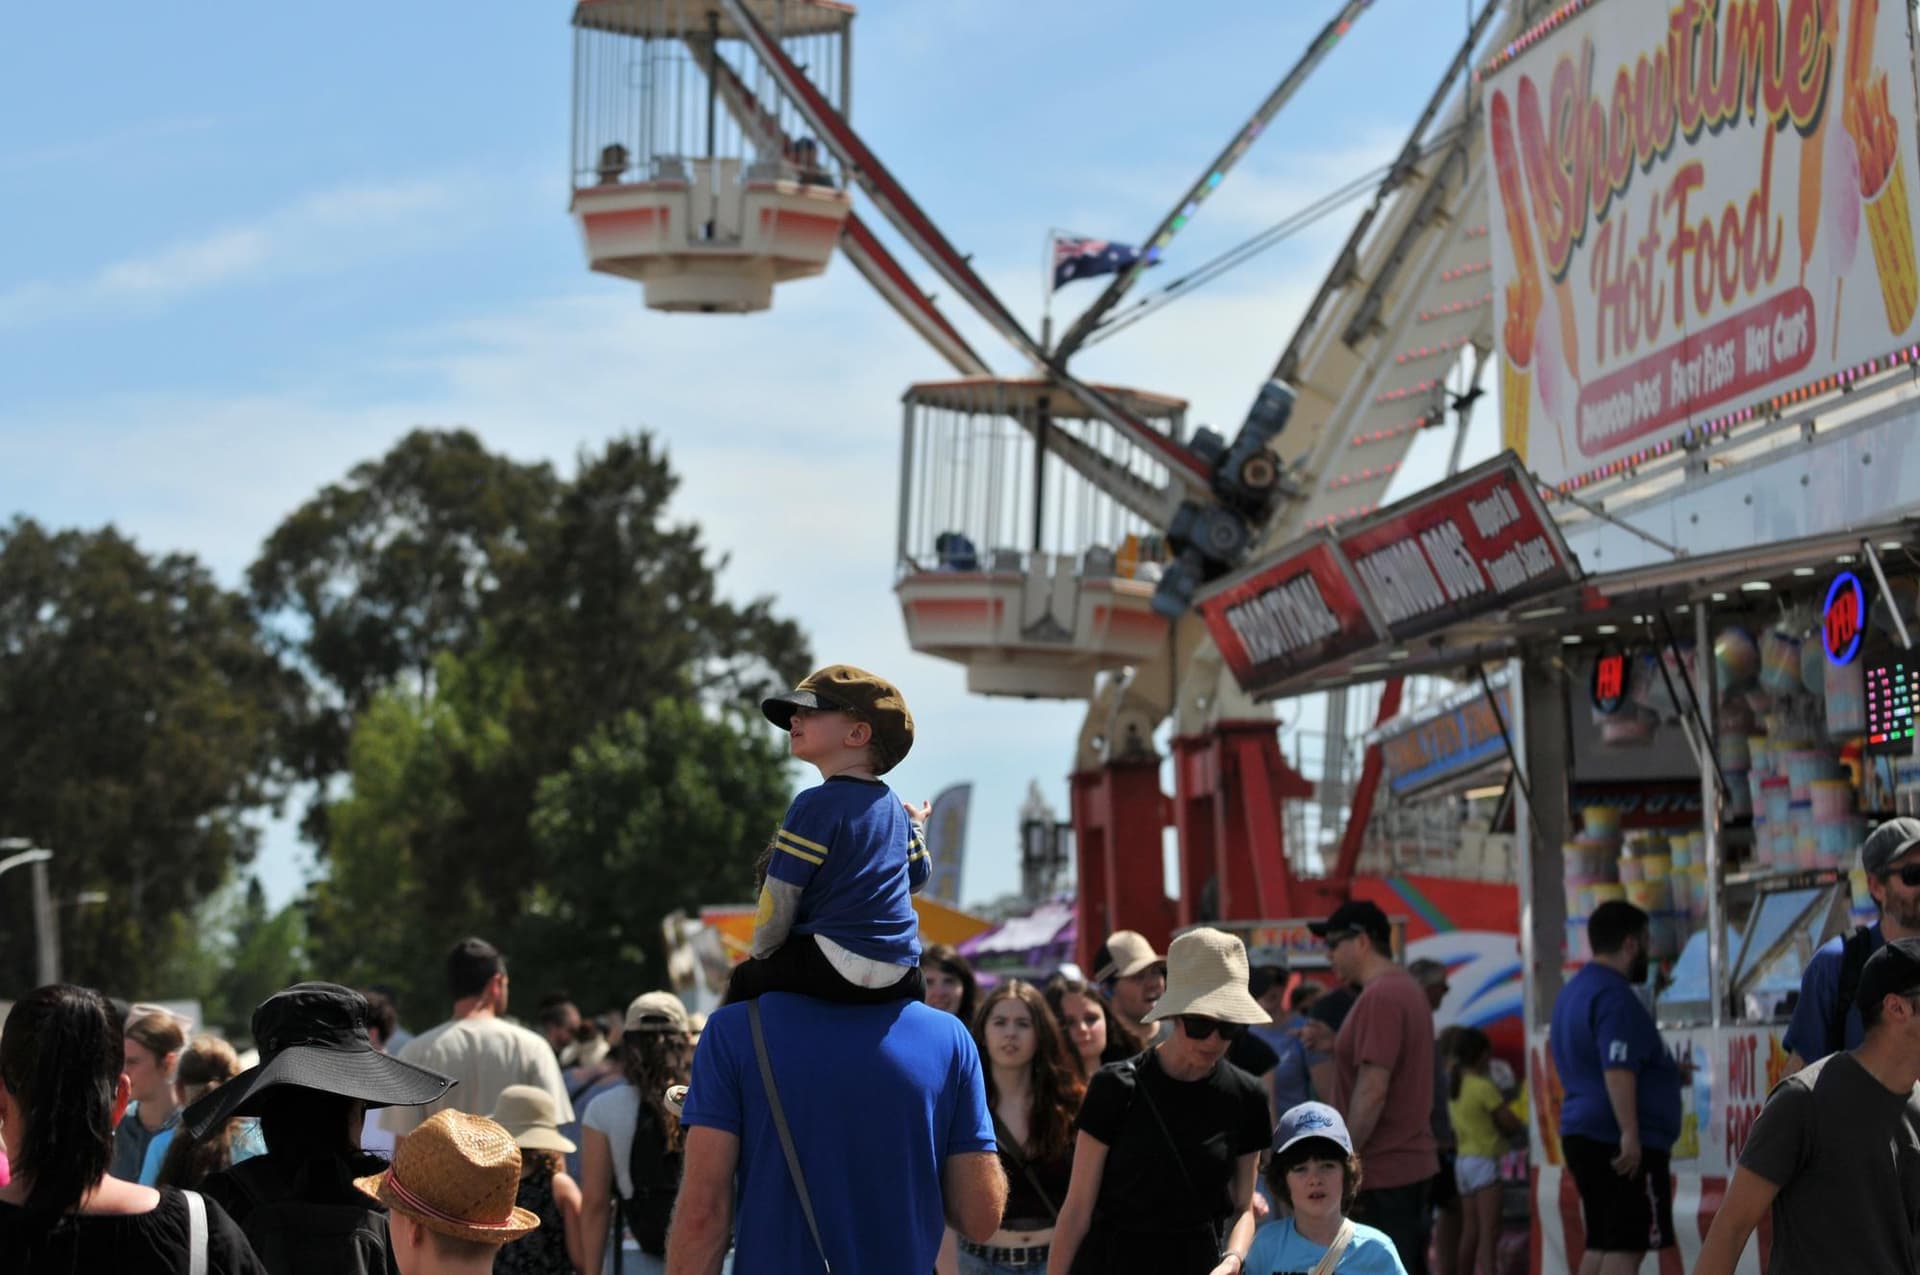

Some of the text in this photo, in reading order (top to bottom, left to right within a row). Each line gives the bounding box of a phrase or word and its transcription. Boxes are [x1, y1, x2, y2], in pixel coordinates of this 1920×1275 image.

[1546, 0, 1831, 282] Showtime
[1590, 122, 1783, 368] Hot Food
[1725, 1103, 1762, 1168] FO
[1727, 1034, 1758, 1099] HOT
